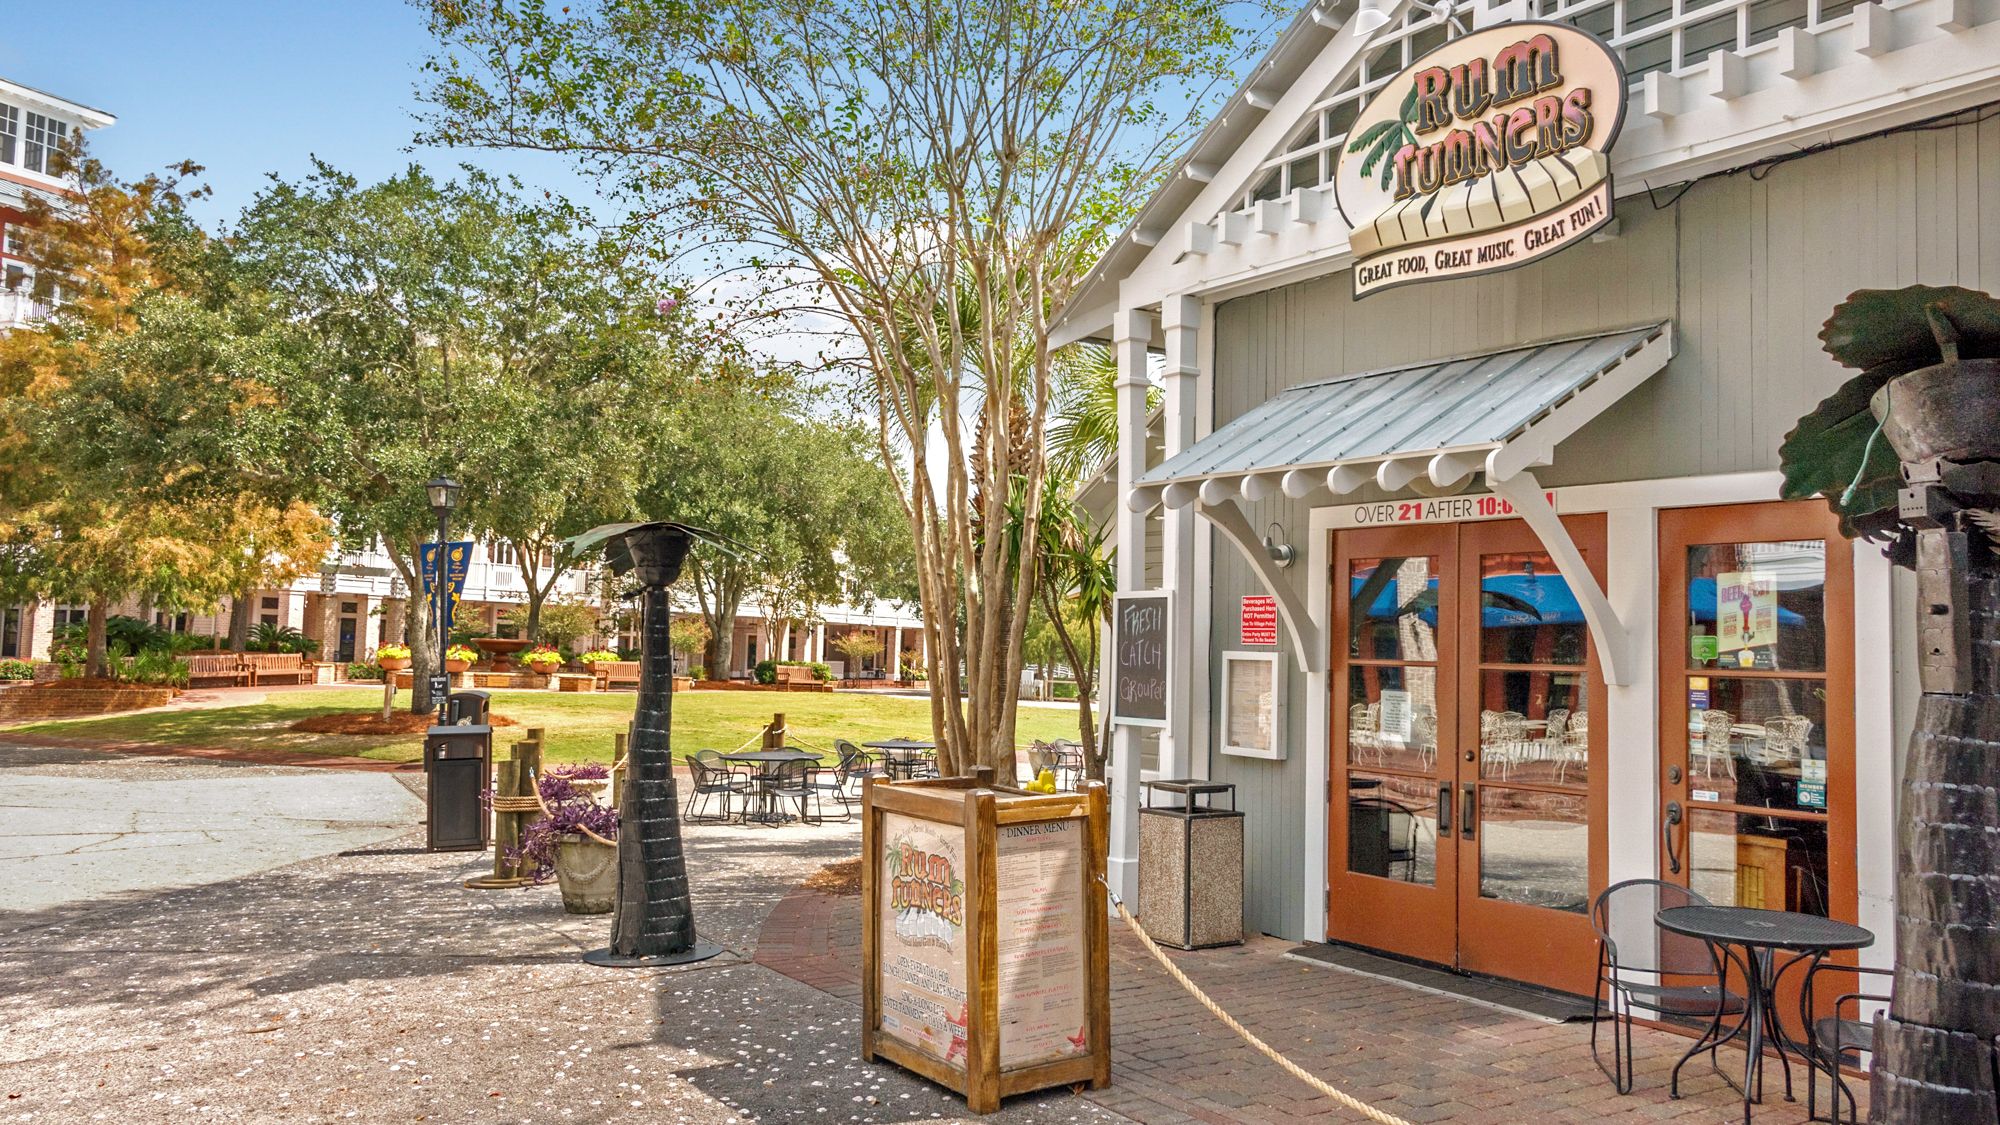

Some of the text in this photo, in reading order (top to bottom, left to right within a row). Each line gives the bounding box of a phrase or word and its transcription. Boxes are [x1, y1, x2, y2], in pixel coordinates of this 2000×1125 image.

[1359, 261, 1394, 286] GREAT
[1397, 256, 1428, 275] FOOD,
[1435, 249, 1473, 270] GREAT
[1524, 219, 1566, 251] GREAT
[1355, 505, 1395, 523] OVER
[1398, 503, 1423, 521] 21
[1425, 499, 1473, 519] AFTER
[1124, 605, 1162, 637] FRESH
[1120, 641, 1162, 670] CATCH
[1007, 821, 1070, 838] DINNER MENU
